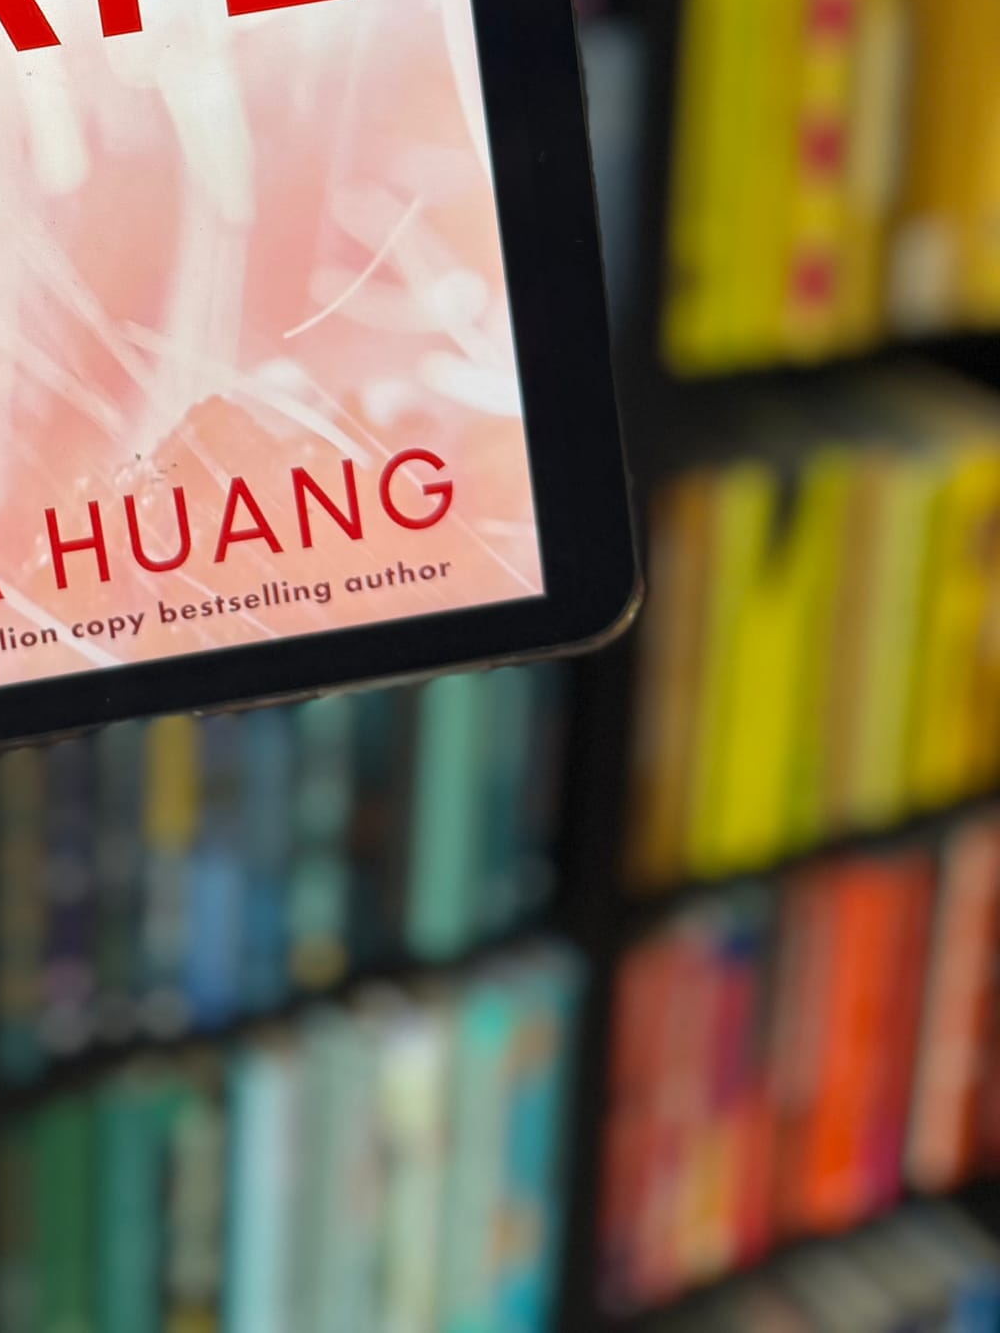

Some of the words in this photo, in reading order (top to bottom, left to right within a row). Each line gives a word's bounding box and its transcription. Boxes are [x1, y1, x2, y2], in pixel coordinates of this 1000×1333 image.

[42, 447, 456, 591] HUANG
[70, 612, 146, 640] copy
[157, 581, 332, 625] bestselling
[344, 559, 453, 594] author
